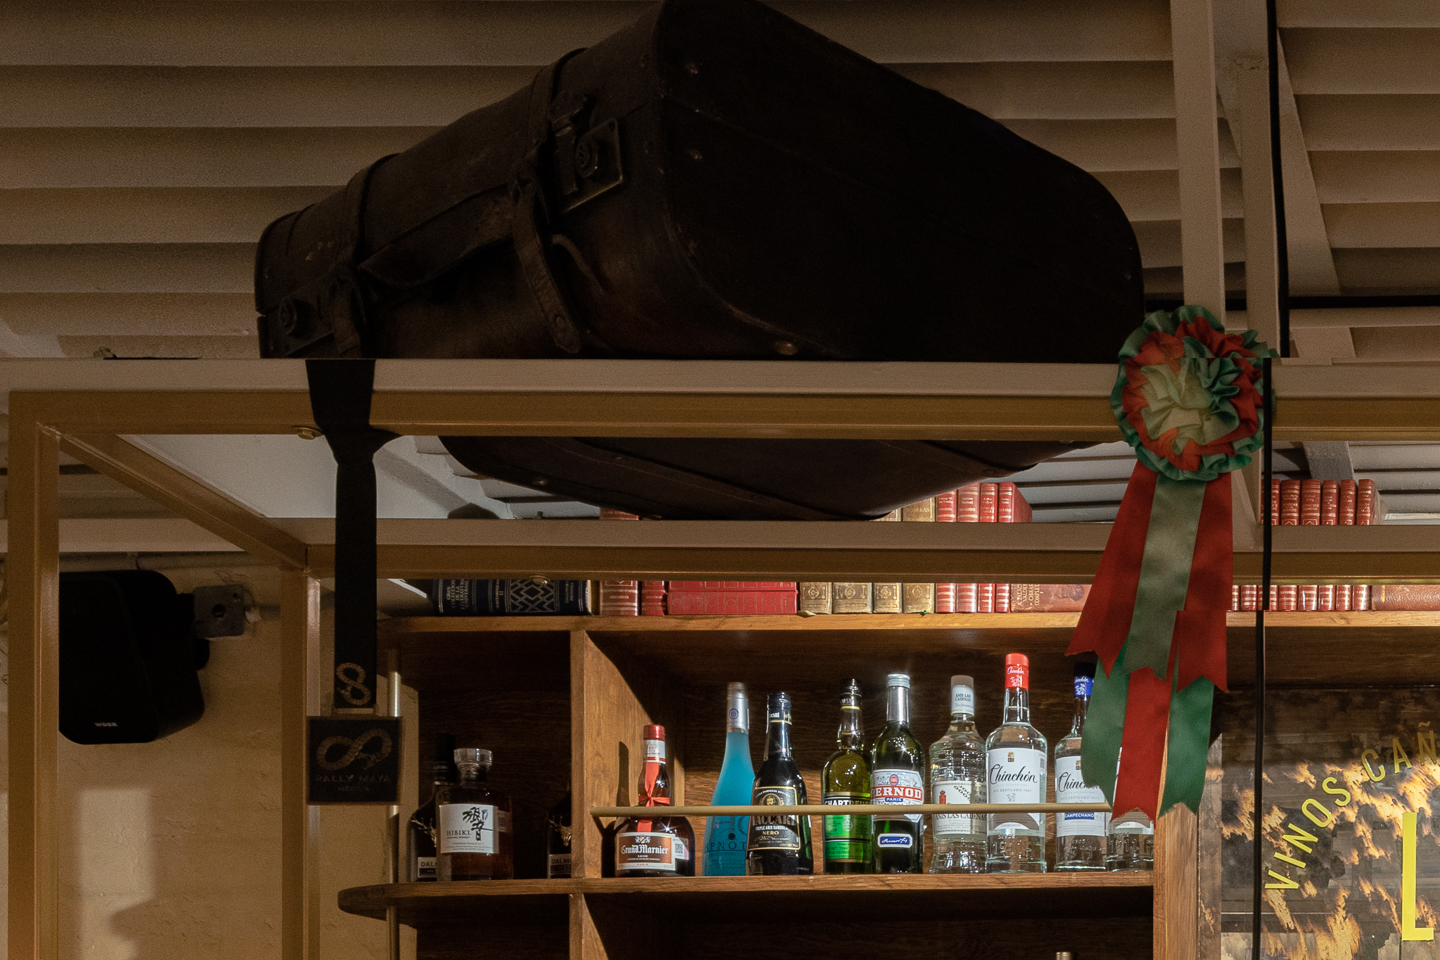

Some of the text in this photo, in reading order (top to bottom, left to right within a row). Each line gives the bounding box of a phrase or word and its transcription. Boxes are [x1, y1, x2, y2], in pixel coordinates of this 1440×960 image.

[990, 763, 1038, 784] Chinchón
[871, 787, 922, 798] PERNOD
[1264, 776, 1352, 891] VINOS
